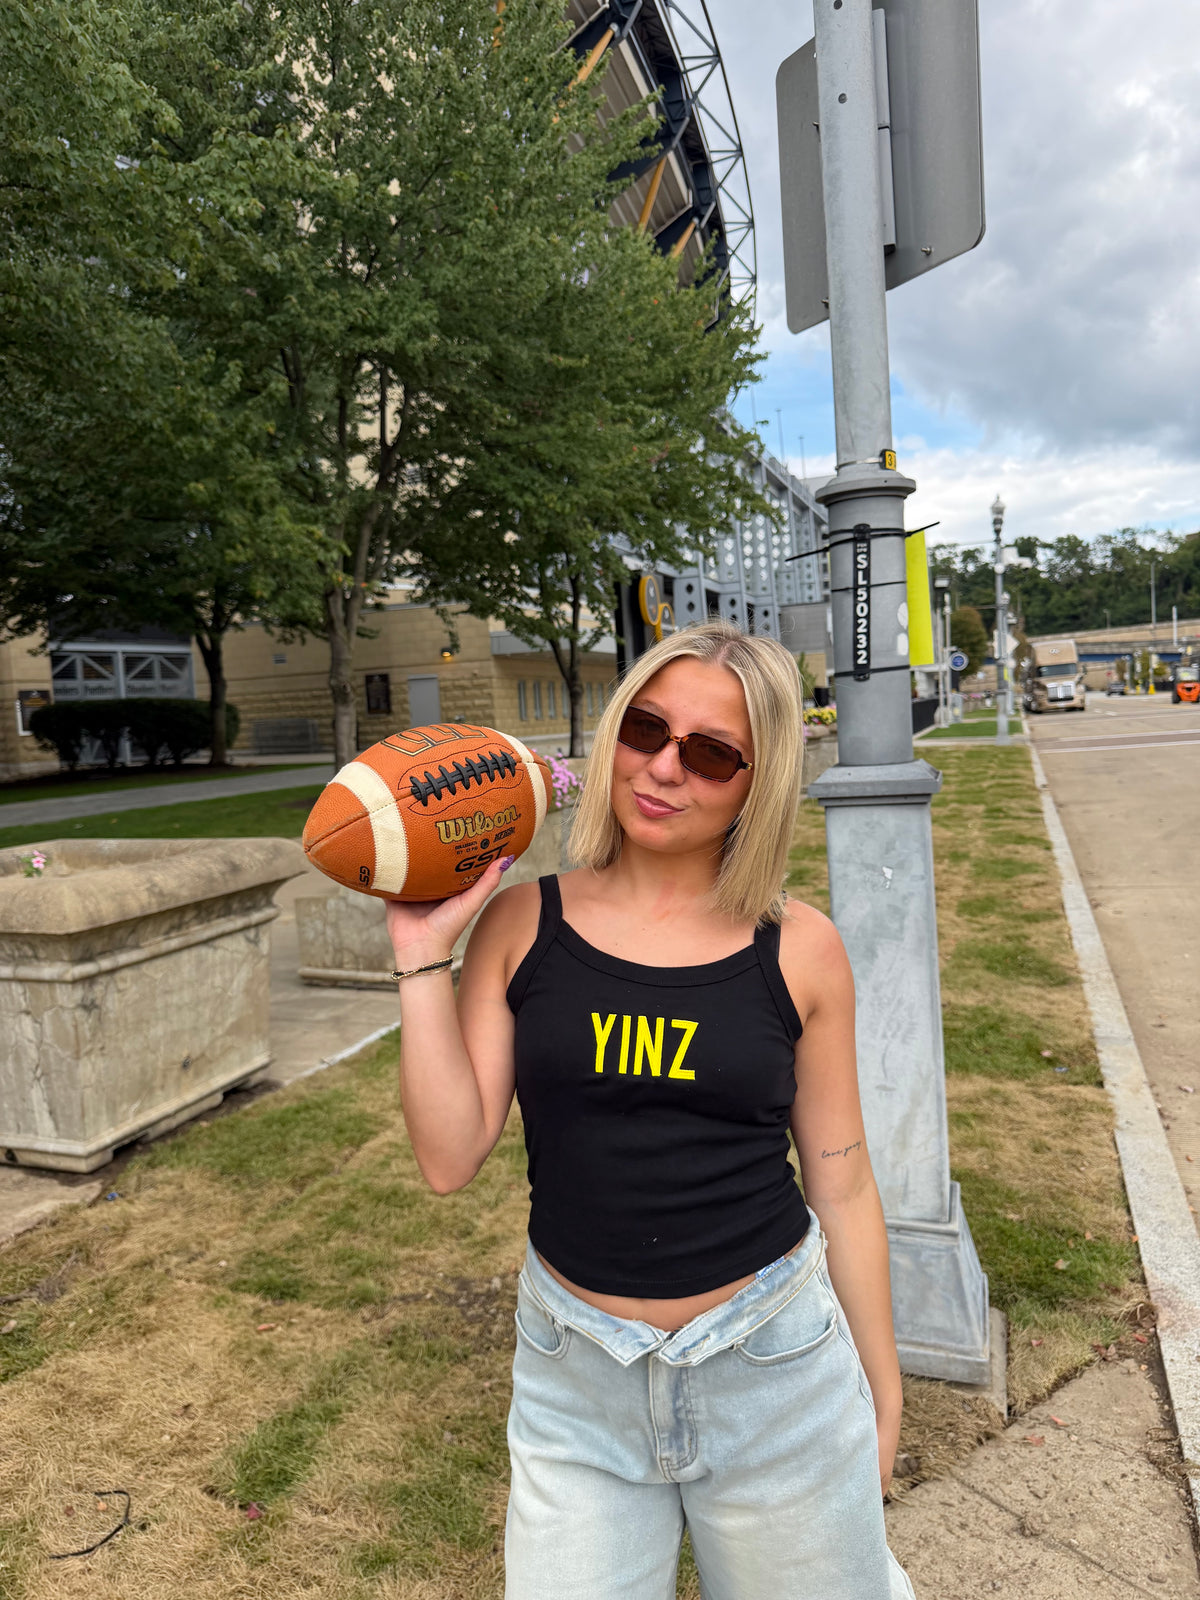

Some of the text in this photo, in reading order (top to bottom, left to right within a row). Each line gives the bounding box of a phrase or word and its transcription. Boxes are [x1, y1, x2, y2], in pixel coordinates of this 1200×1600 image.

[856, 553, 868, 665] SL50232
[435, 804, 517, 844] Wilson
[455, 841, 510, 873] GST
[591, 1012, 699, 1080] YINZ
